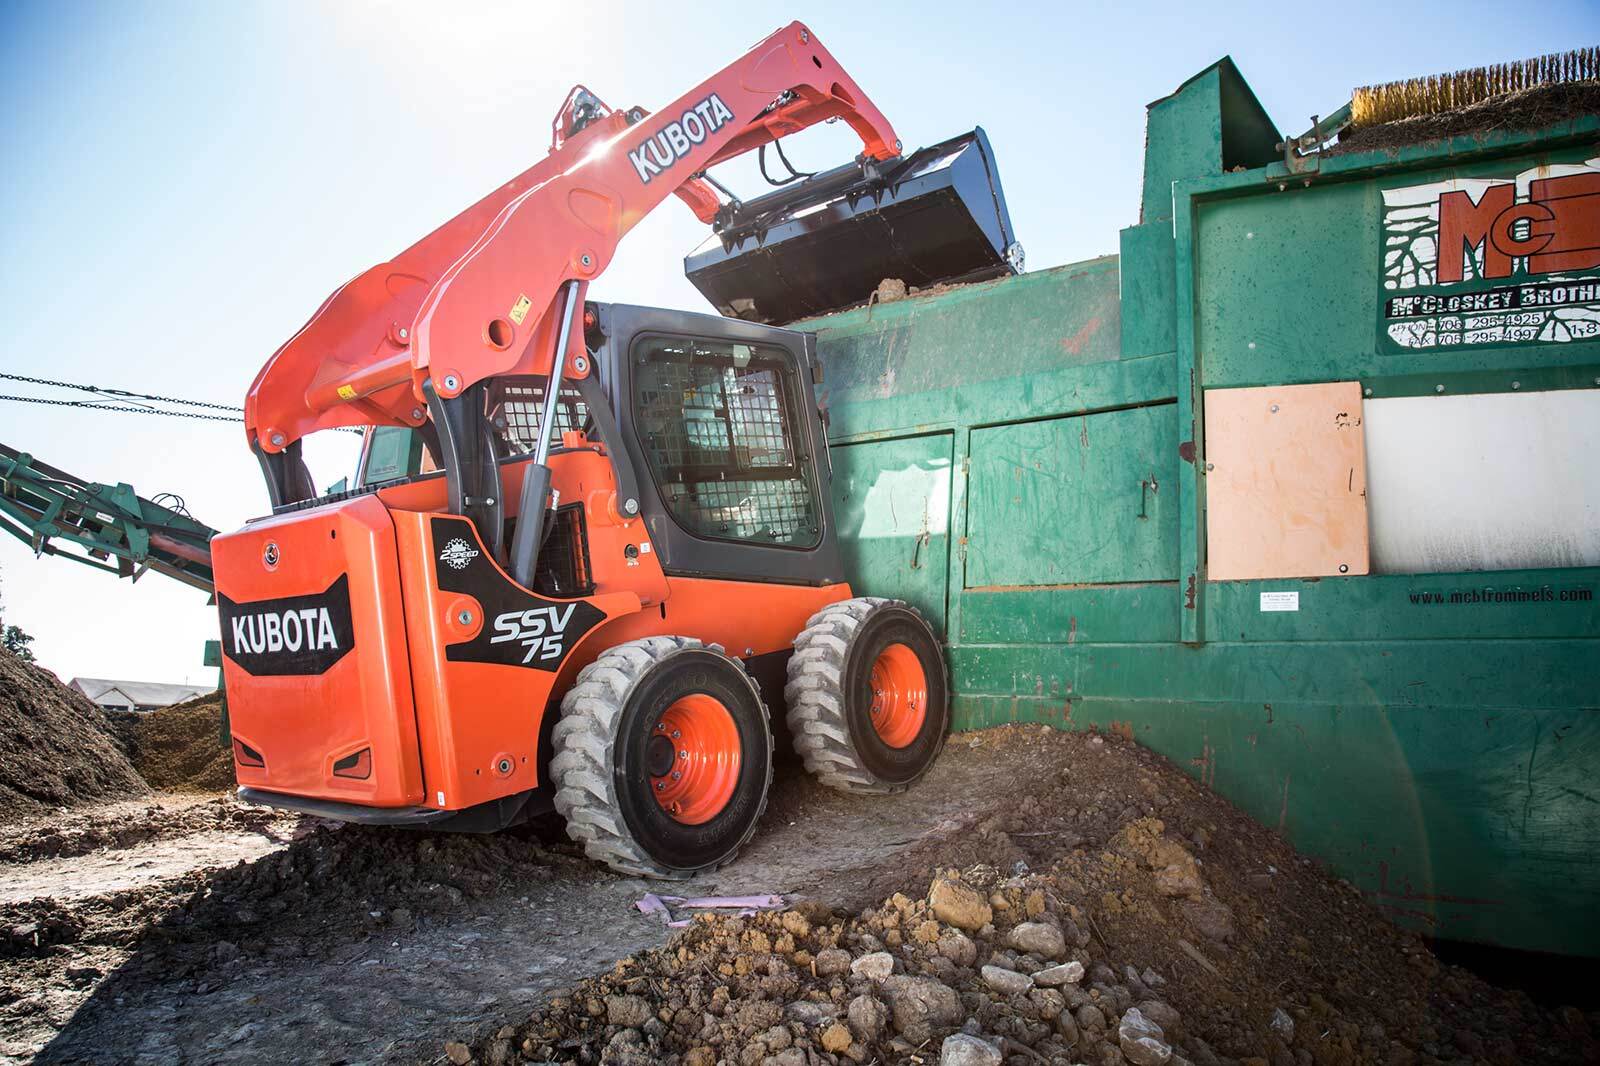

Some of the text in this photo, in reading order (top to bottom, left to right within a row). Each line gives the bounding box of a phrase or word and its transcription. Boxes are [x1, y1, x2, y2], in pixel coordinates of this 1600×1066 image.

[628, 93, 734, 183] KUBOTA
[1520, 284, 1600, 307] BROTH
[231, 606, 339, 655] KUBOTA
[490, 602, 577, 645] SSV
[521, 633, 565, 665] 75
